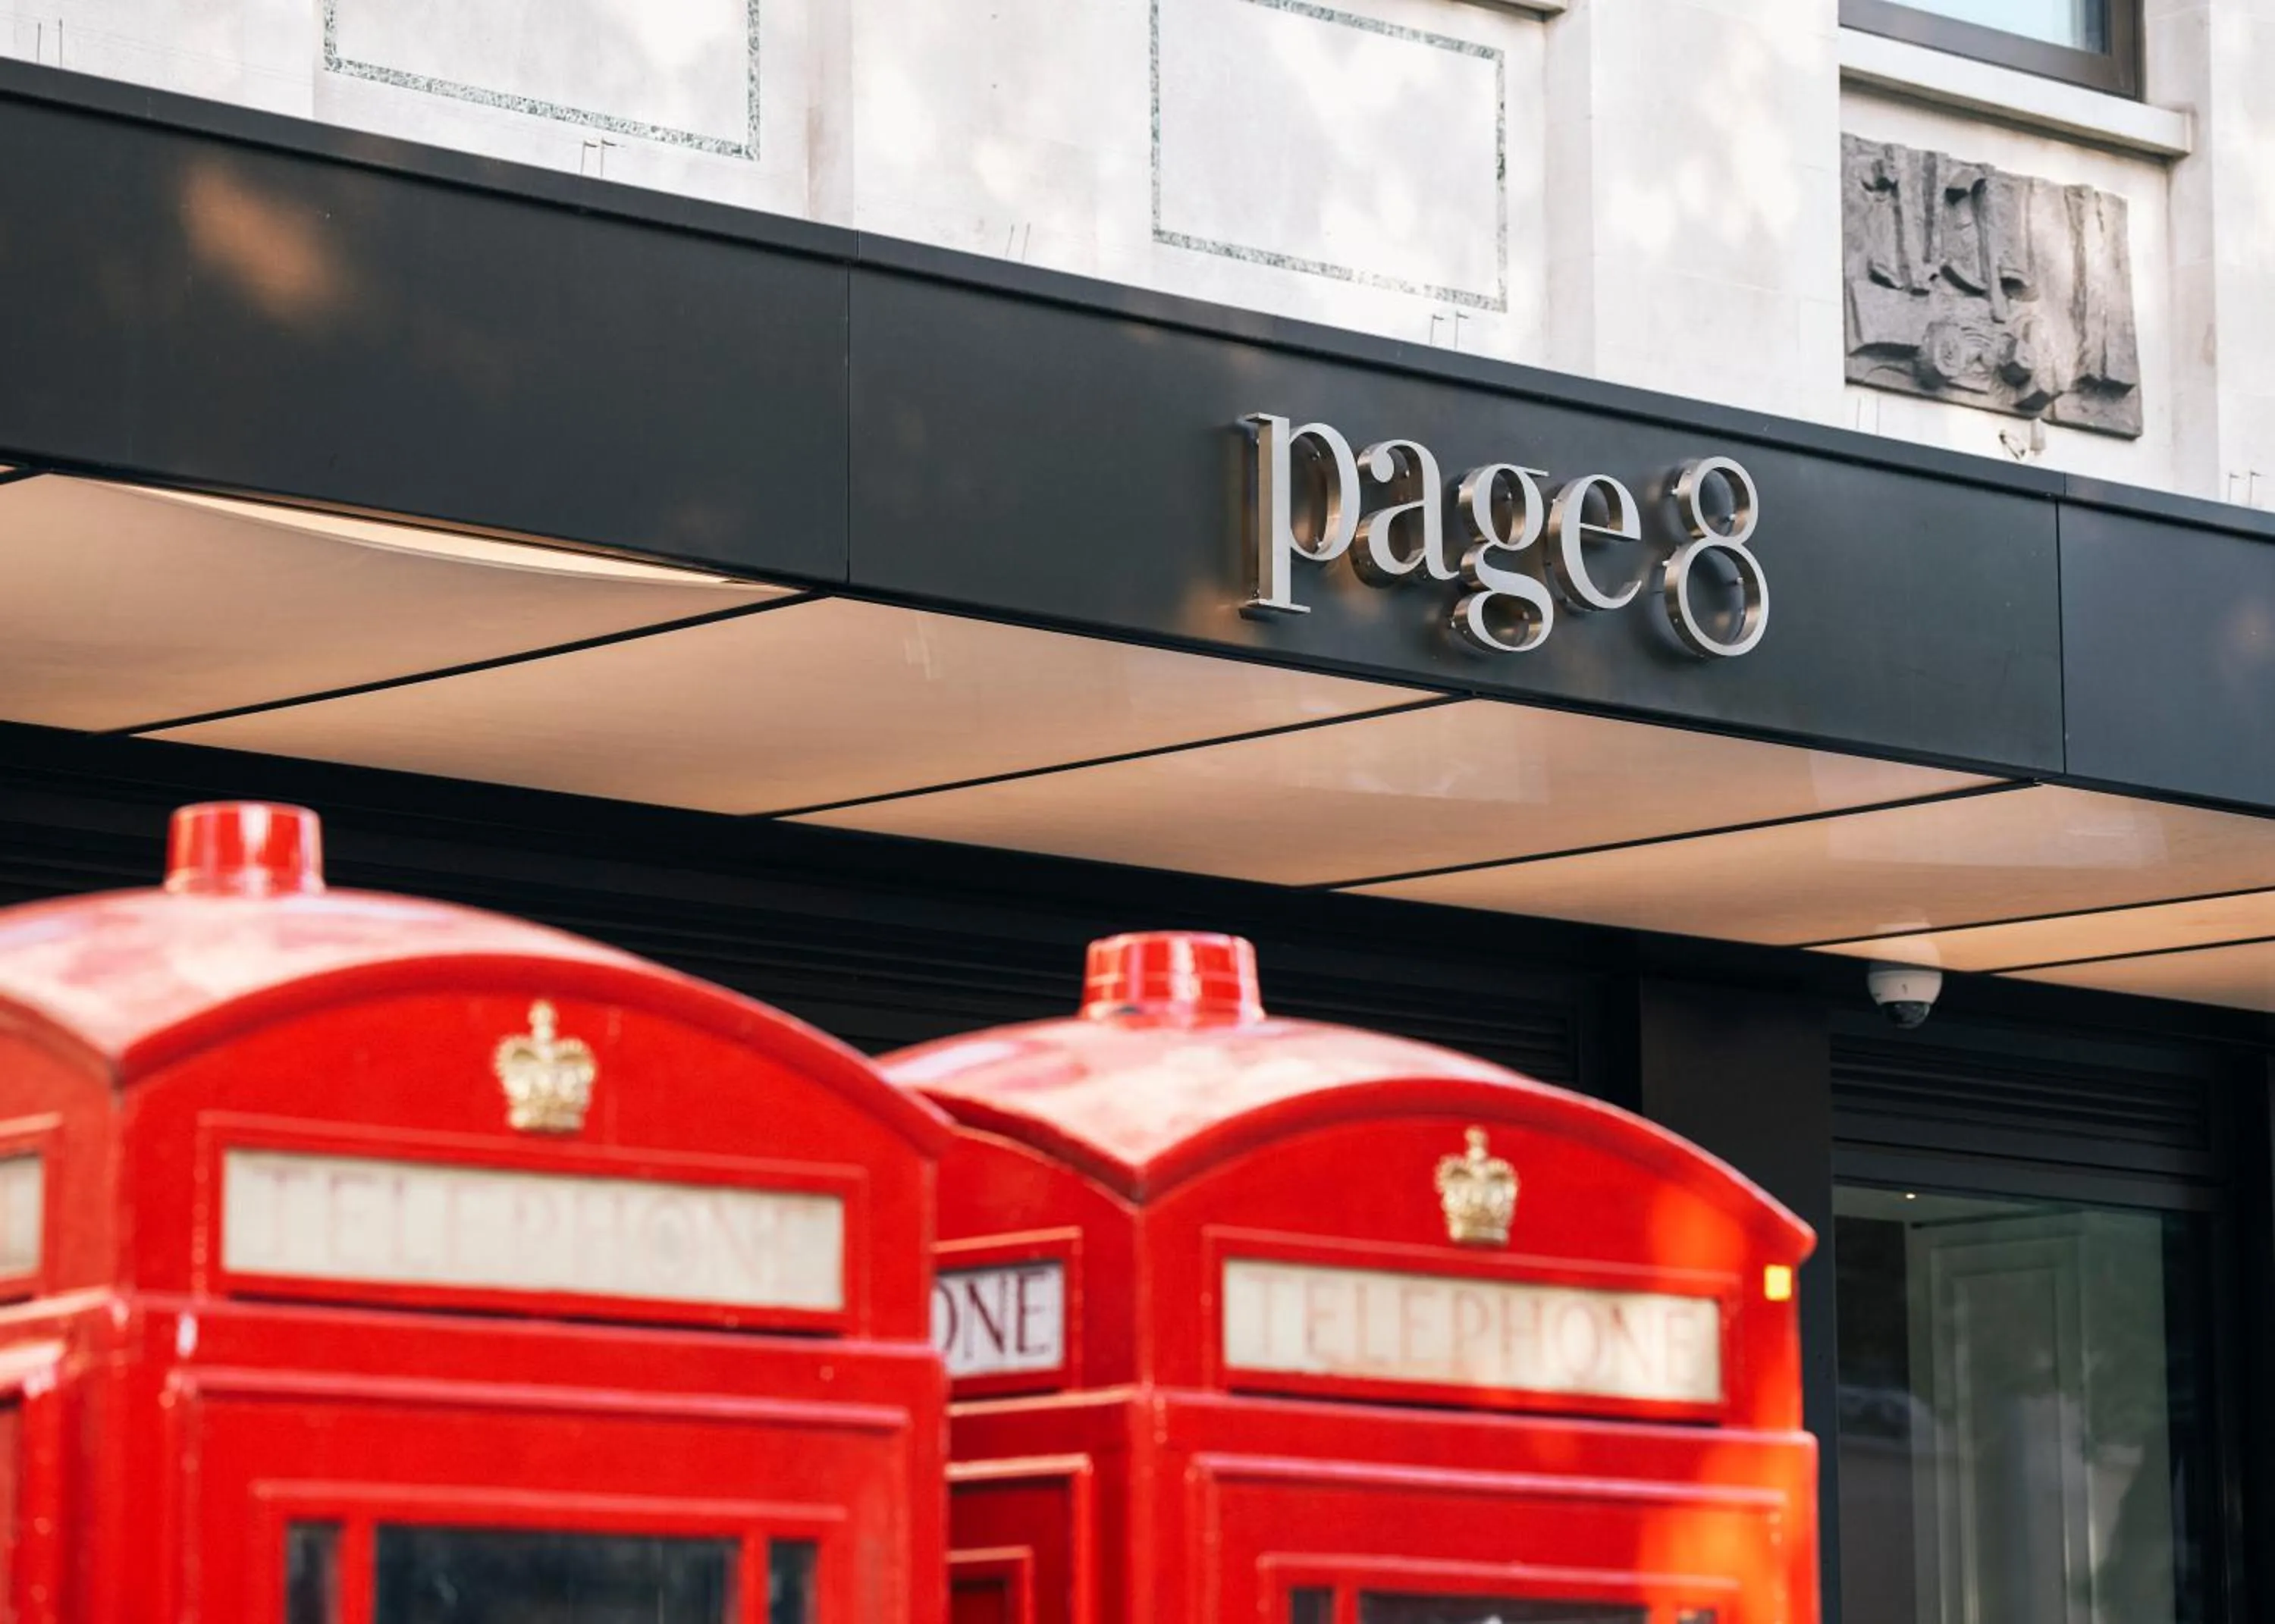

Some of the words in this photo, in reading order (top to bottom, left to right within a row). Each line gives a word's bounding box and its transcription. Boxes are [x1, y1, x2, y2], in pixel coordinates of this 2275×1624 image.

[1239, 413, 1642, 653] page
[1665, 456, 1769, 657] 8
[1244, 1269, 1699, 1386] TELEPHONE
